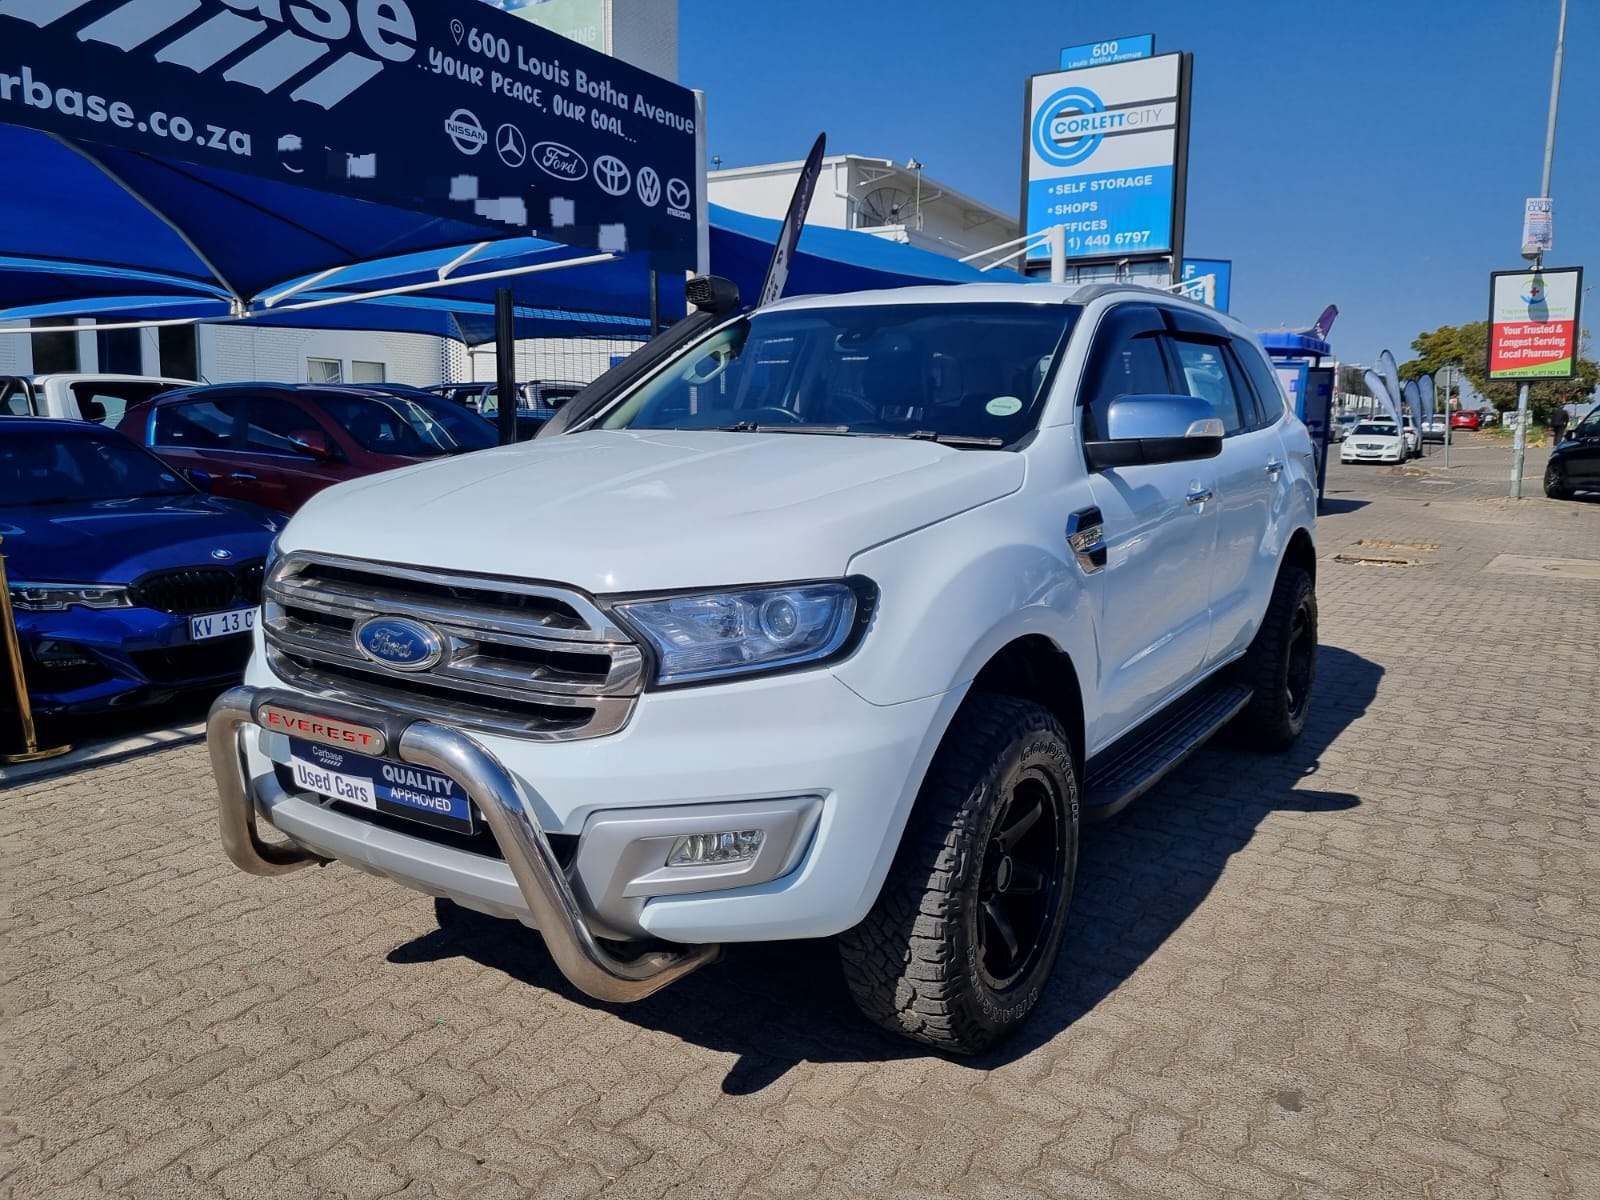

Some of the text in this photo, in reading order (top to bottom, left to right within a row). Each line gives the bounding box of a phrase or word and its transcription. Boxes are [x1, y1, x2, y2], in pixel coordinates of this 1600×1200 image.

[1092, 41, 1118, 57] 600
[1068, 51, 1142, 68] Louis Botha Avenue
[467, 27, 694, 134] 600 Louis Botha Avenue
[491, 70, 547, 113] PEACE,
[552, 94, 586, 123] OUR
[447, 122, 485, 141] NISSAN
[542, 146, 578, 175] Ford
[1055, 175, 1153, 195] SELF STORAGE
[1055, 201, 1098, 215] SHOPS
[1084, 234, 1111, 247] 440
[1114, 230, 1151, 244] 6797
[1503, 324, 1563, 335] Your Trusted &
[1499, 336, 1566, 348] Longest Serving
[1499, 349, 1565, 359] Local Pharmacy
[194, 610, 257, 637] KV 13 C
[370, 627, 414, 658] Ford
[268, 712, 373, 746] EVEREST
[312, 746, 344, 763] Carbase
[298, 764, 369, 803] Used Cars
[382, 764, 454, 796] QUALITY
[390, 786, 452, 813] APPROVED
